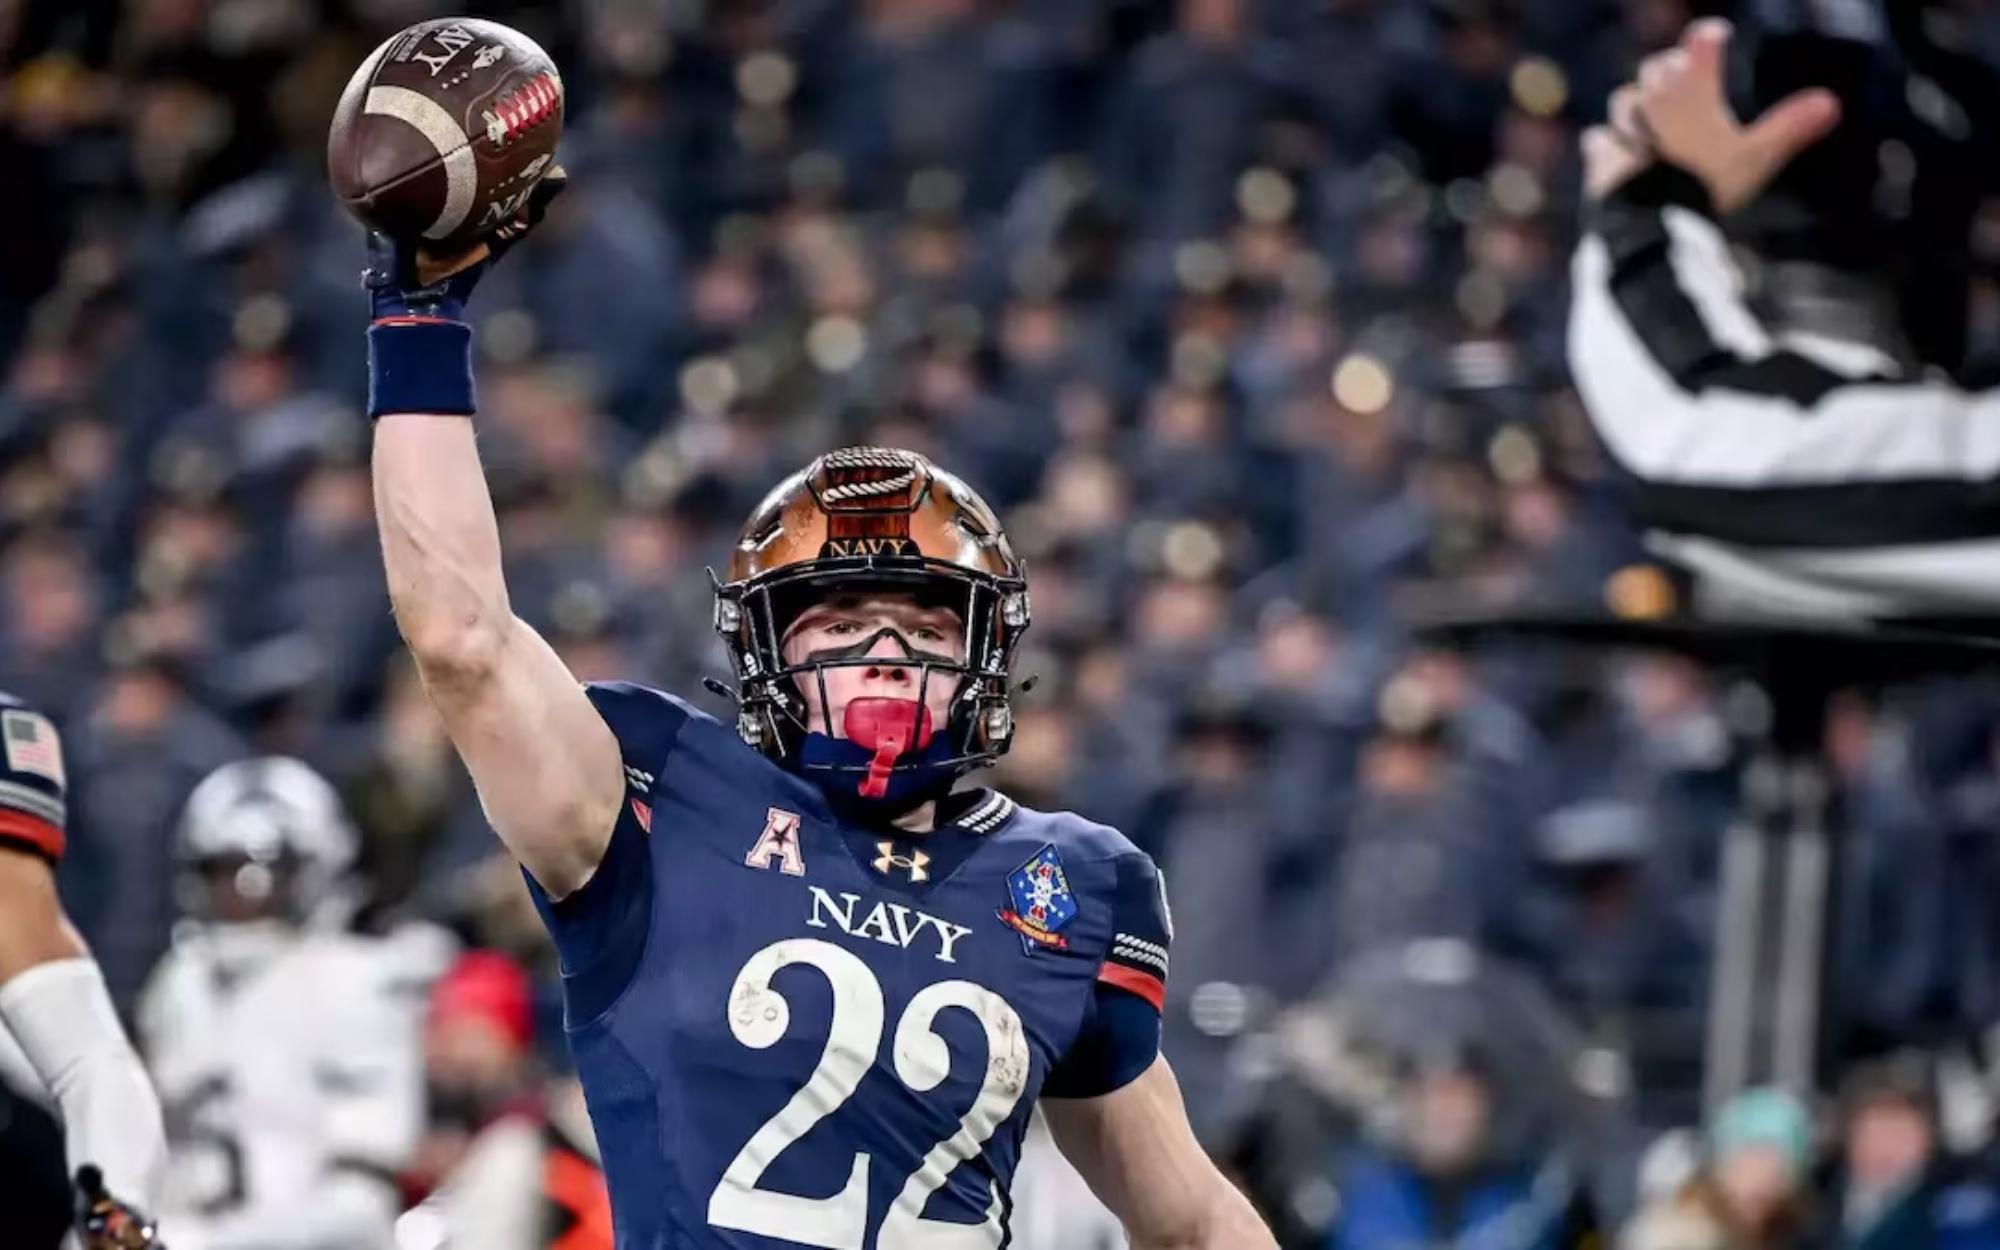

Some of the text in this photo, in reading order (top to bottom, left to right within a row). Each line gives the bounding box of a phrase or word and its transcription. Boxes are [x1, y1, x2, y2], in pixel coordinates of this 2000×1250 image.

[412, 25, 475, 77] AVY
[829, 539, 909, 558] NAVY
[805, 885, 973, 963] NAVY
[707, 938, 1030, 1250] 22
